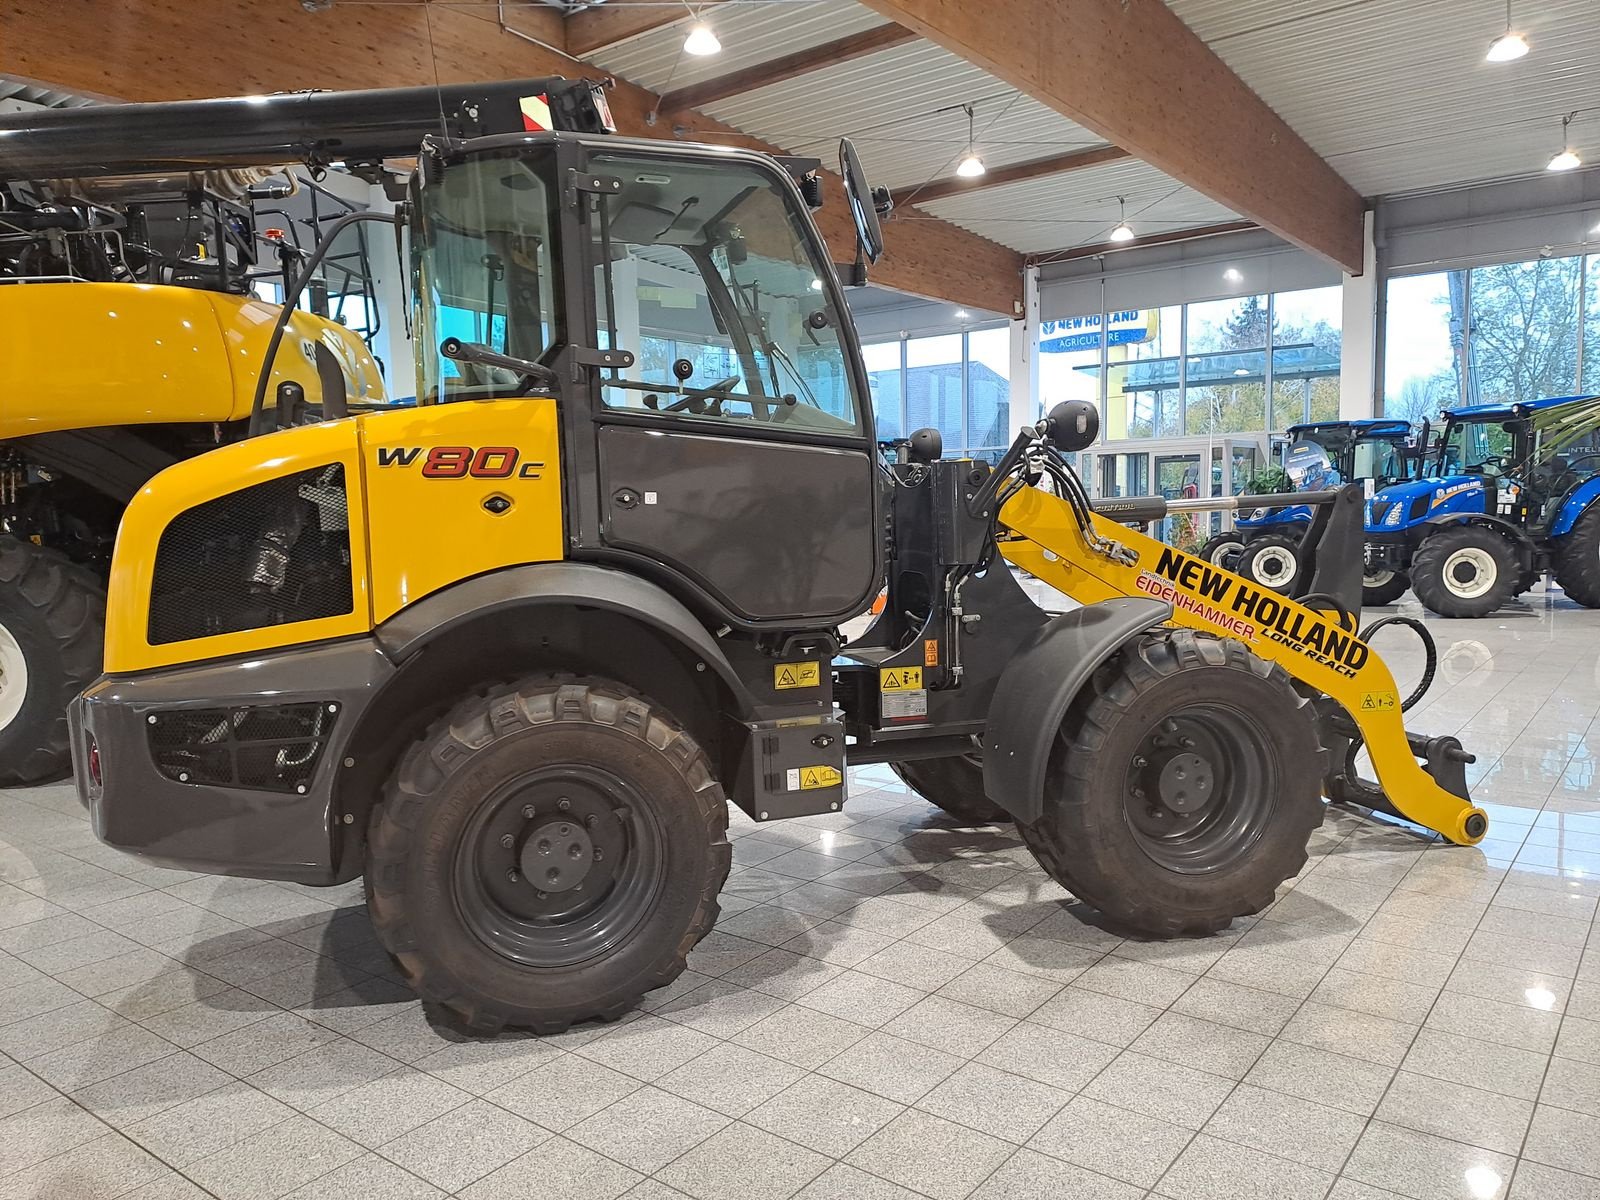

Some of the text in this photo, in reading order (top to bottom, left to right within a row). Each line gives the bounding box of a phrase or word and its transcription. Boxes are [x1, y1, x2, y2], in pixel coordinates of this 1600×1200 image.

[1058, 310, 1138, 330] NEW HOAND
[1060, 332, 1120, 347] AGRICULTRE
[1140, 568, 1176, 588] Landtechnik
[1135, 574, 1256, 641] EIDENHAMMER
[1154, 547, 1369, 671] NEW HOLLAND
[1260, 627, 1358, 679] LONG REACH
